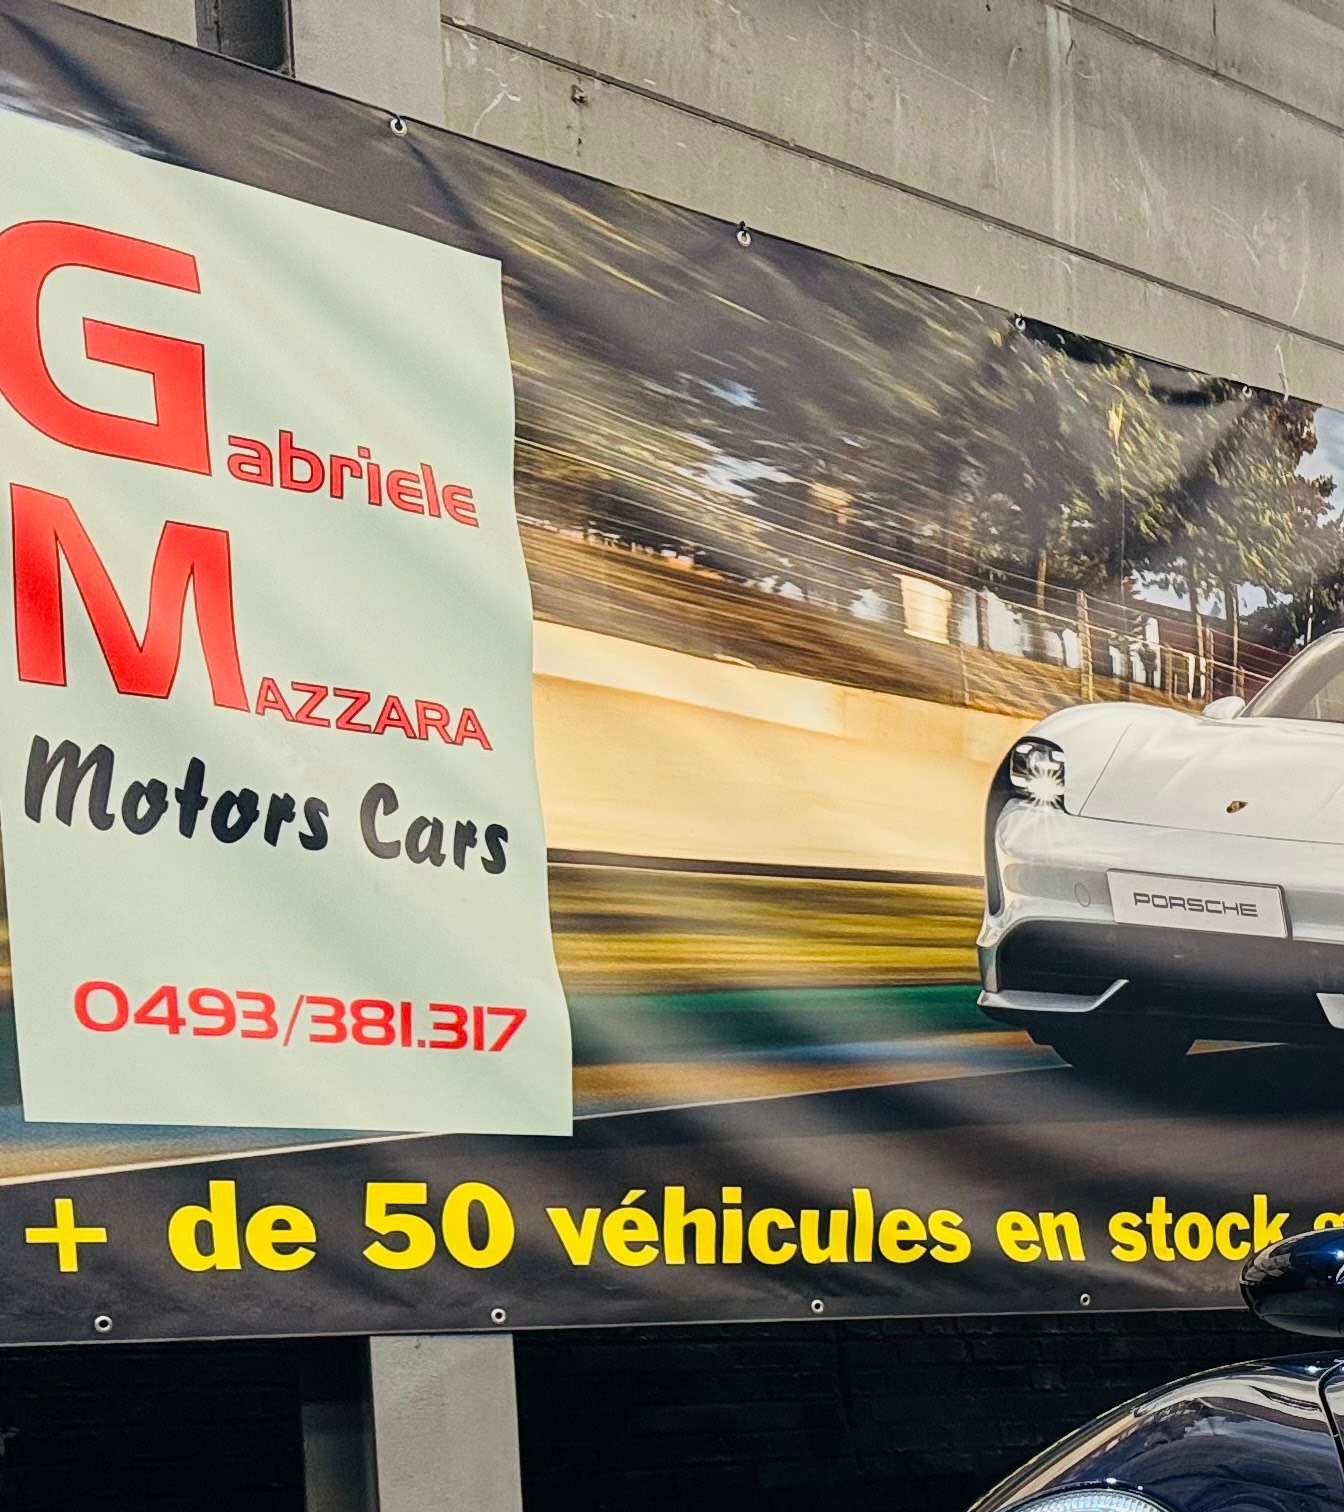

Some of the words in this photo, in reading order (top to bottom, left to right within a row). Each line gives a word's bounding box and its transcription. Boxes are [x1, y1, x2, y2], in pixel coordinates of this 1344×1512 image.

[24, 734, 329, 852] Motors
[359, 782, 510, 875] Cars
[1133, 891, 1258, 918] PORSCHE
[72, 980, 528, 1053] 0493/381.317
[25, 1198, 108, 1273] +
[167, 1179, 318, 1272] de
[361, 1180, 516, 1271] 50
[546, 1186, 972, 1266] véhicules
[996, 1207, 1087, 1262] en
[1108, 1193, 1290, 1264] stock
